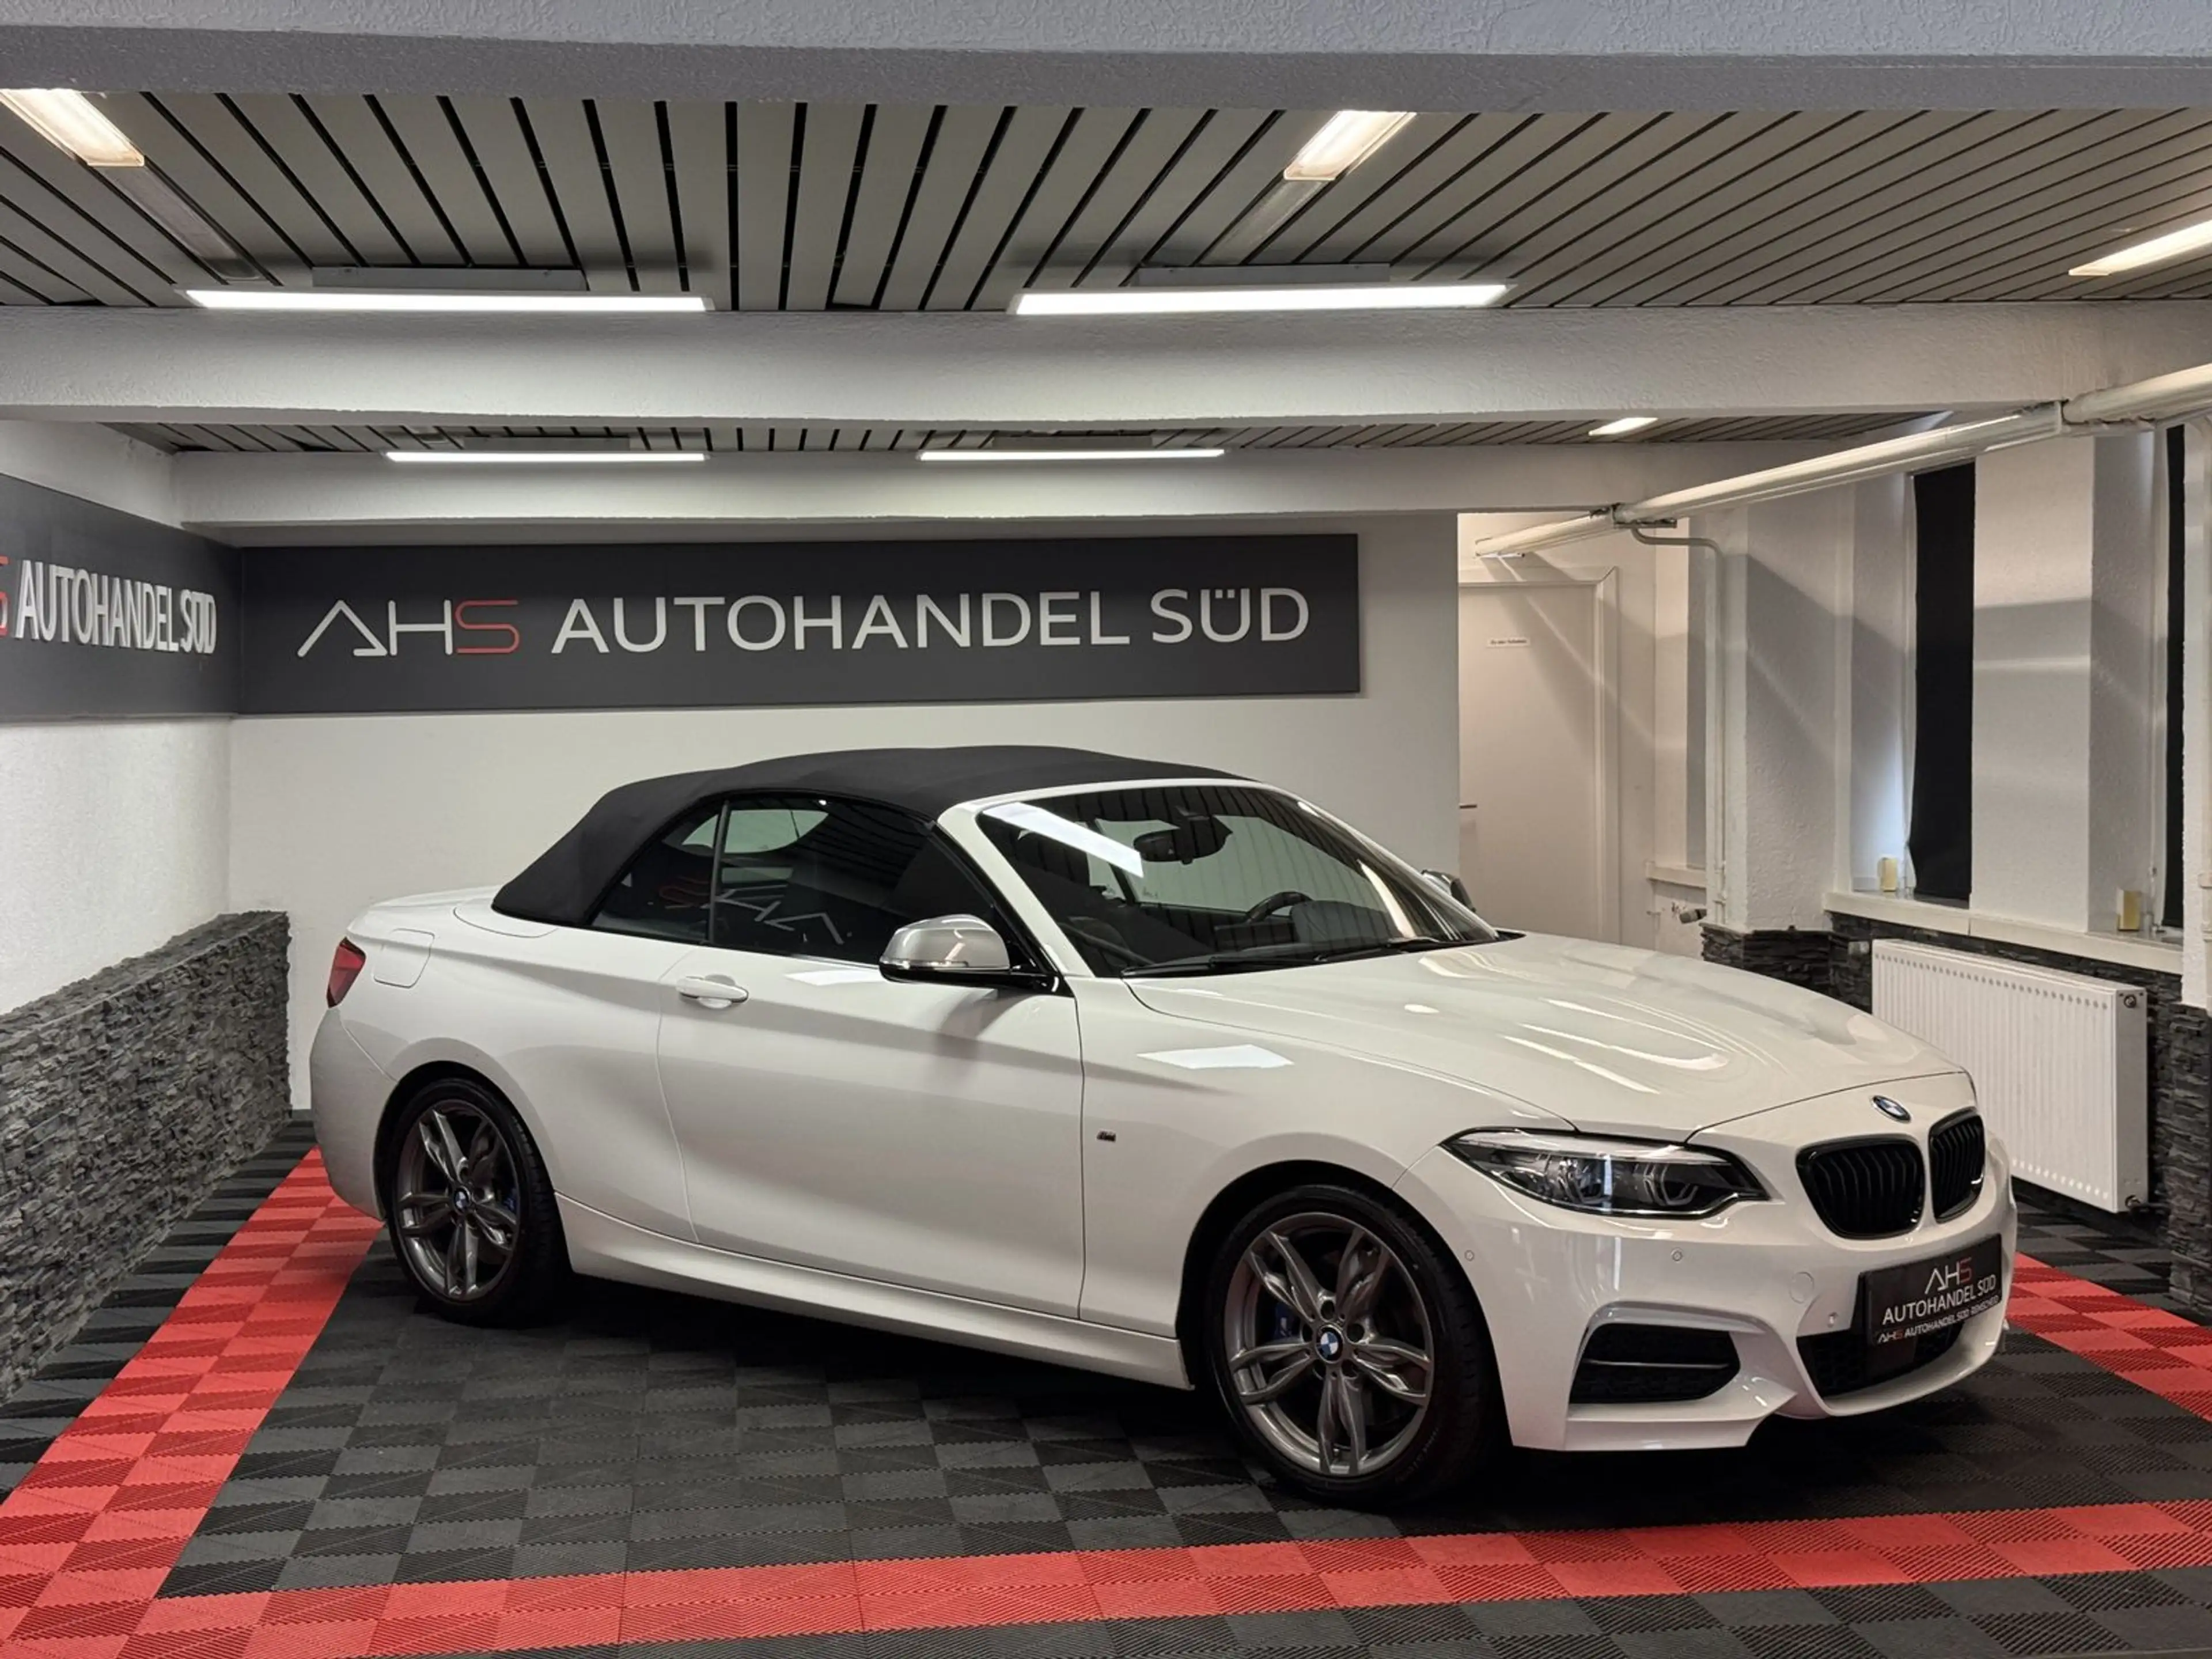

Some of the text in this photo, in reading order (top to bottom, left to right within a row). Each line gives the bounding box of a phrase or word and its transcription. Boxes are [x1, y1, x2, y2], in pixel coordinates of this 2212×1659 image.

[14, 560, 179, 652] AUTOHANDEL
[297, 588, 1309, 657] AHS AUTOHANDEL SÜD
[1925, 1257, 1972, 1294] AHS
[1883, 1285, 1976, 1325] AUTOHANDEL
